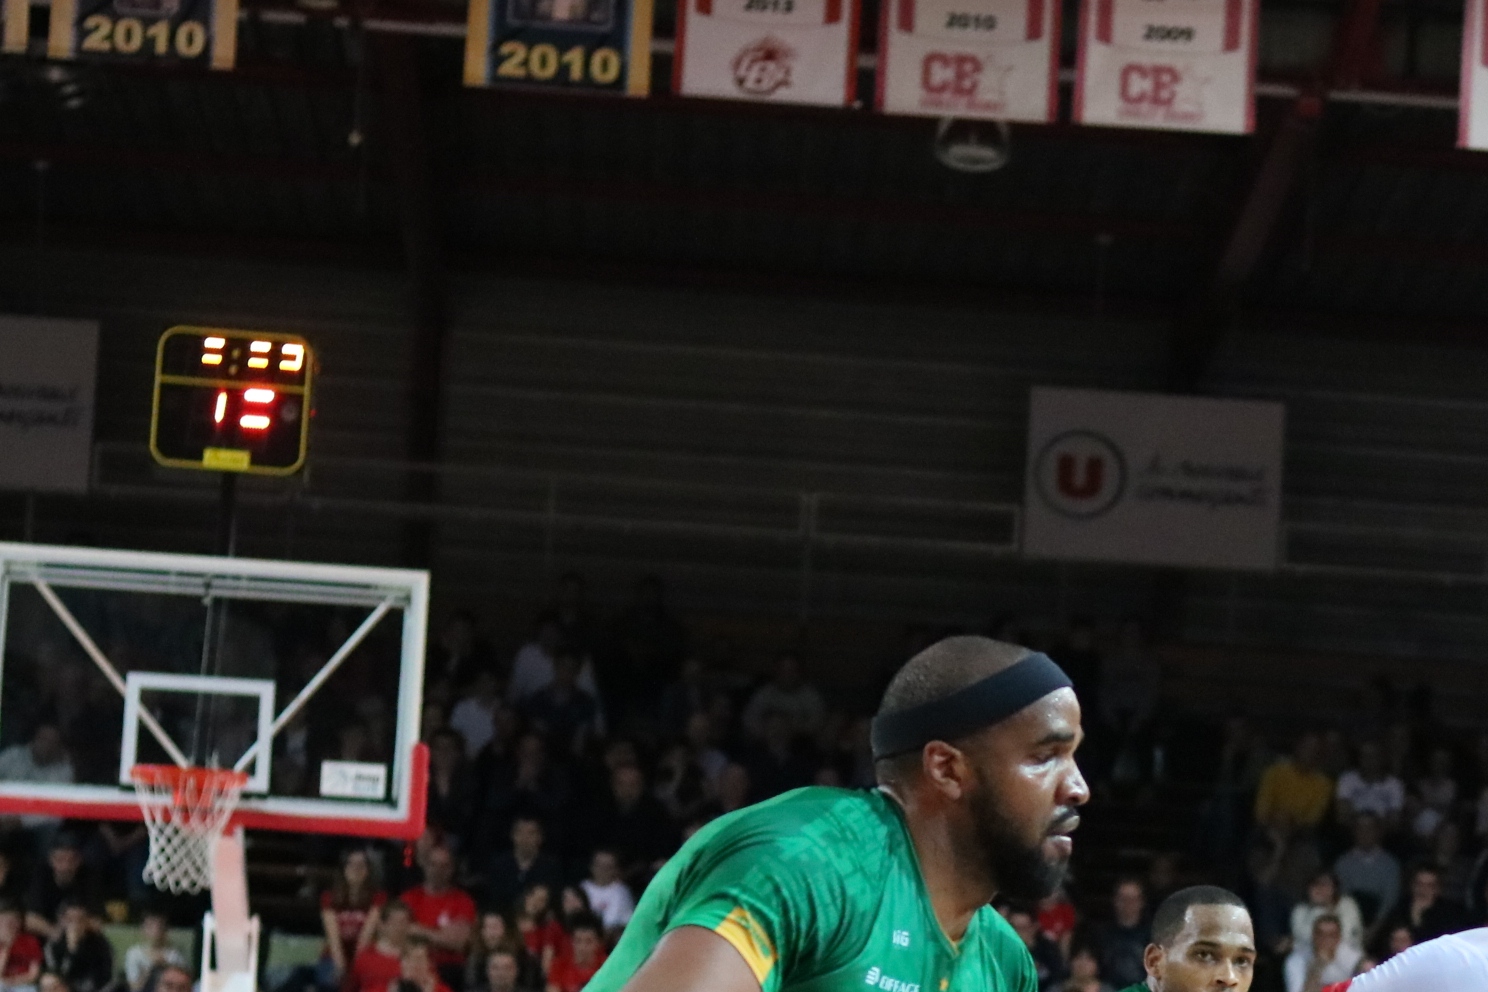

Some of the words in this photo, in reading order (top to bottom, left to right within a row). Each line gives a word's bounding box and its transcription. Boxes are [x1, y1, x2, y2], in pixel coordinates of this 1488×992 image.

[81, 13, 207, 57] 2010
[944, 11, 997, 31] 2010
[497, 40, 621, 84] 2010
